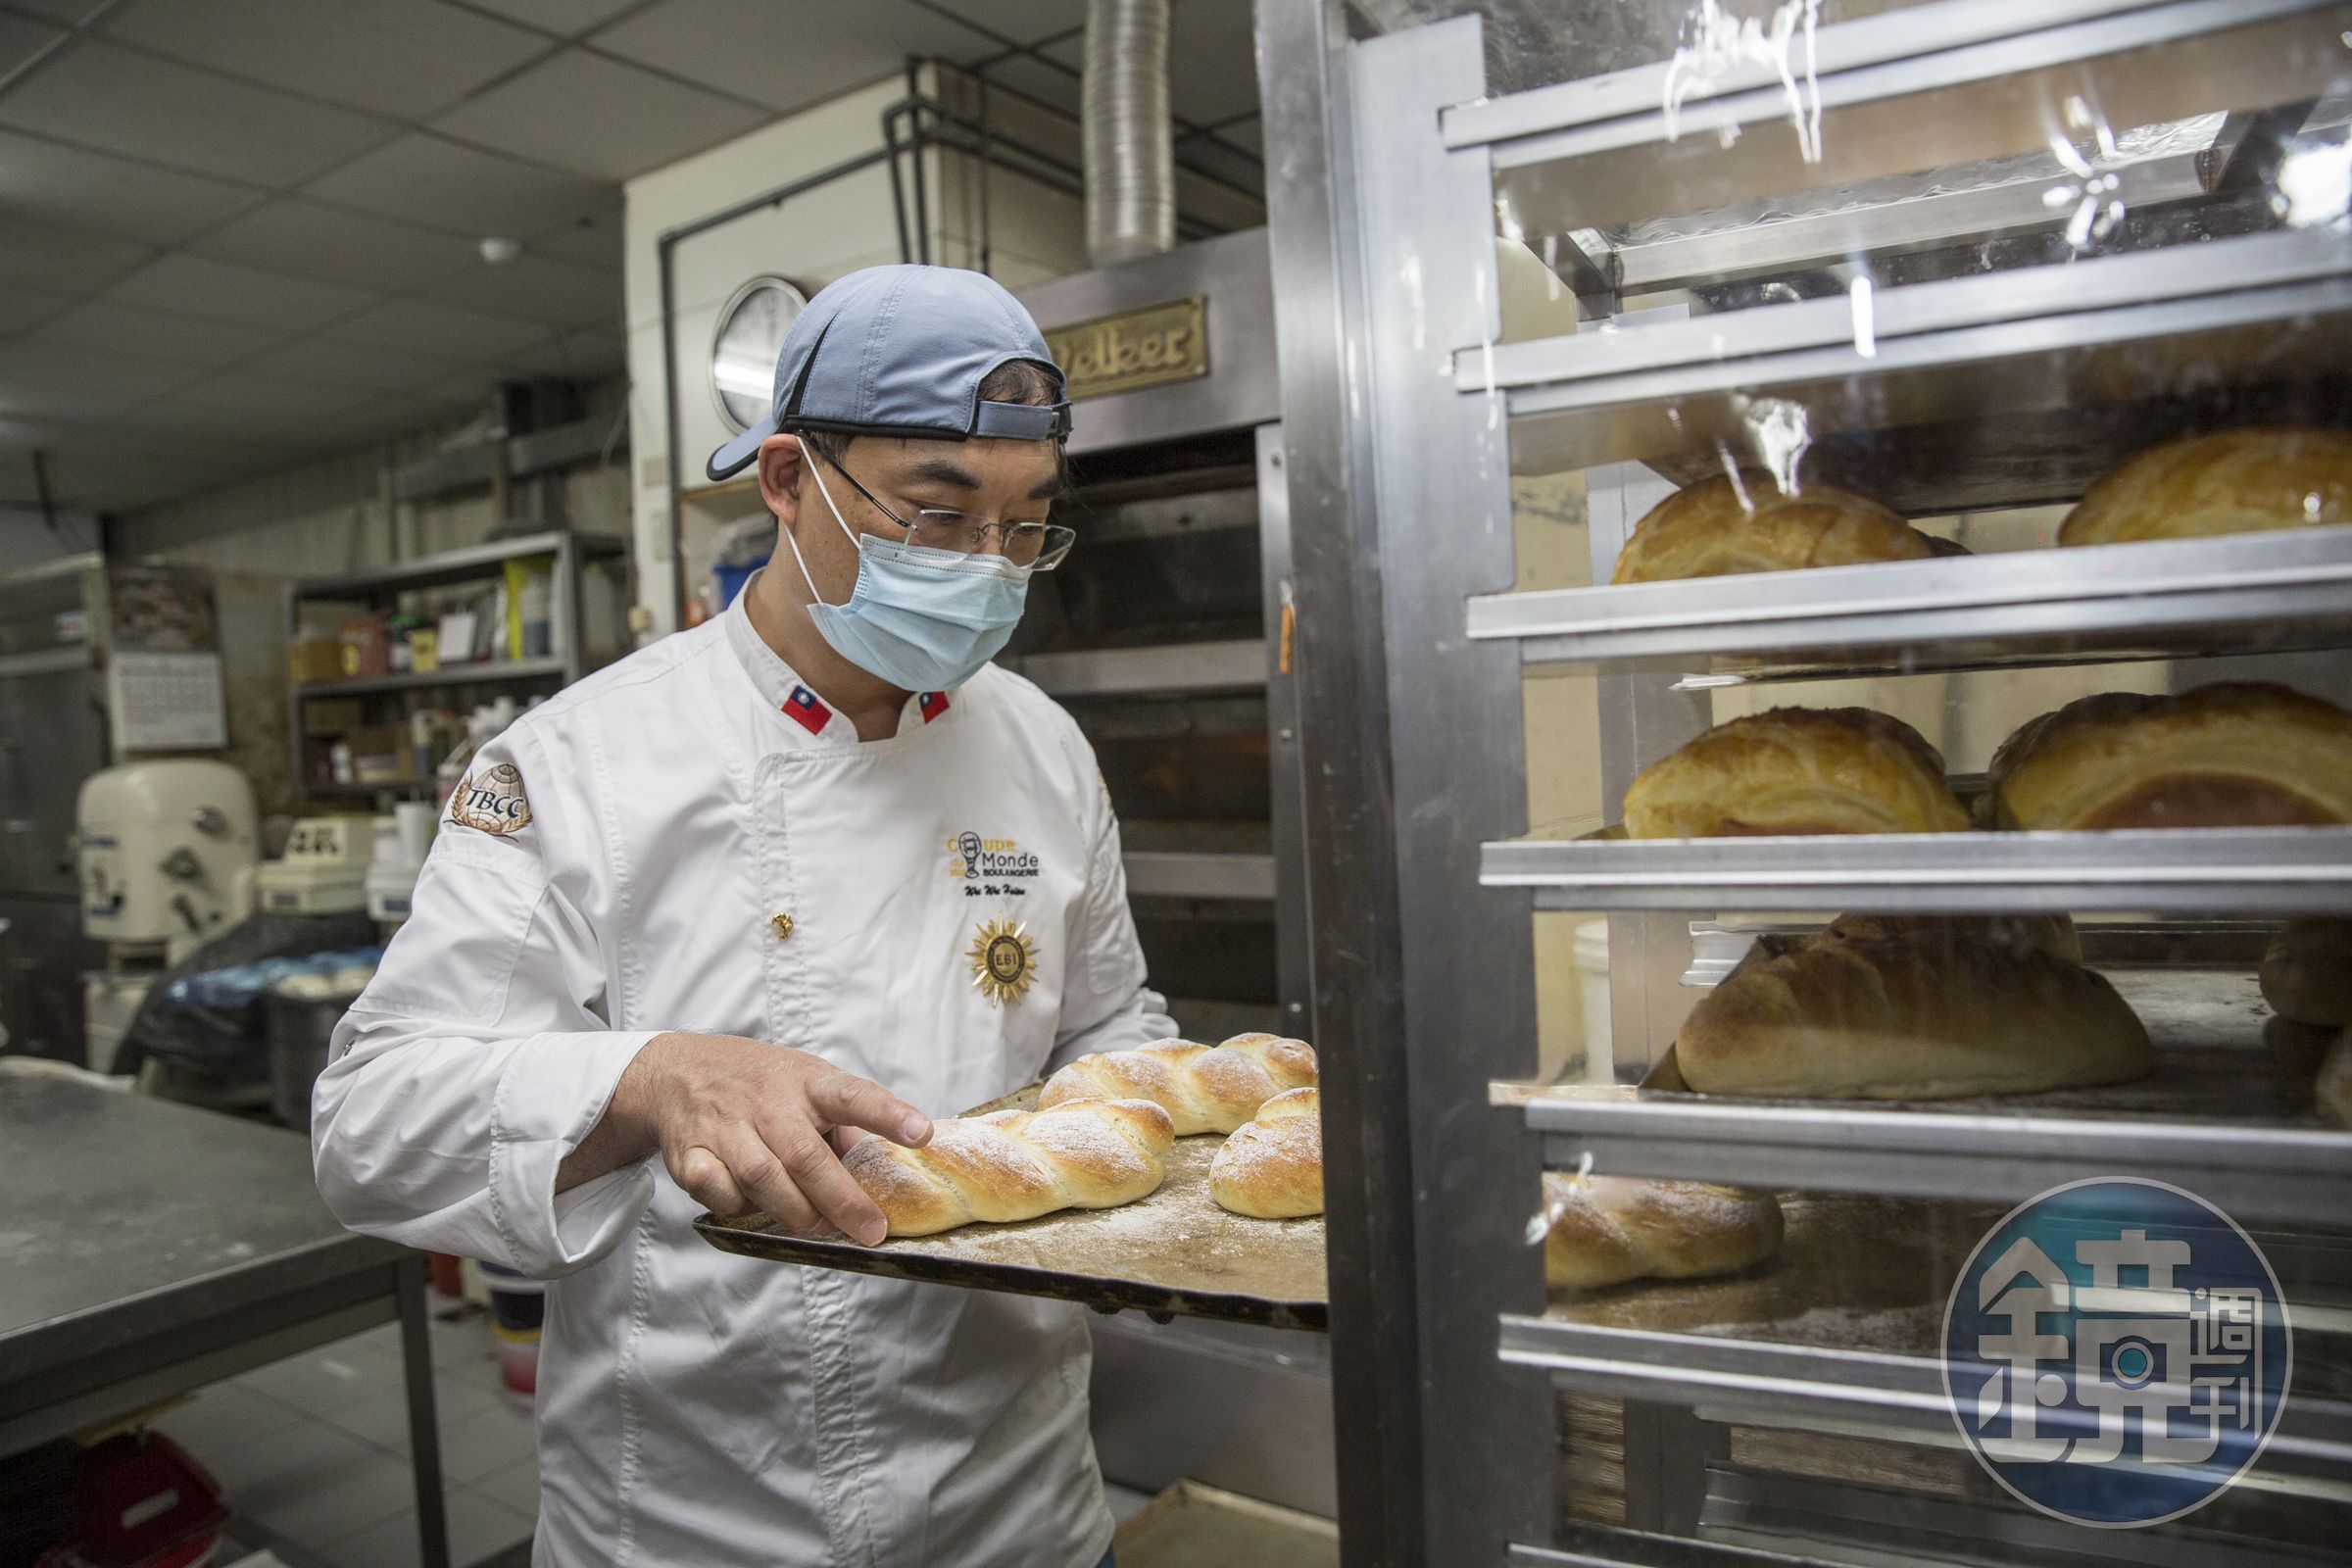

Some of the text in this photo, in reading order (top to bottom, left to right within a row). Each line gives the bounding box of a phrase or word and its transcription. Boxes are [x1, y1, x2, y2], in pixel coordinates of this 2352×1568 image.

[466, 788, 523, 818] TBCC
[982, 852, 1039, 867] Monde
[983, 868, 1039, 877] BOULANGERIE
[995, 953, 1017, 966] EBI
